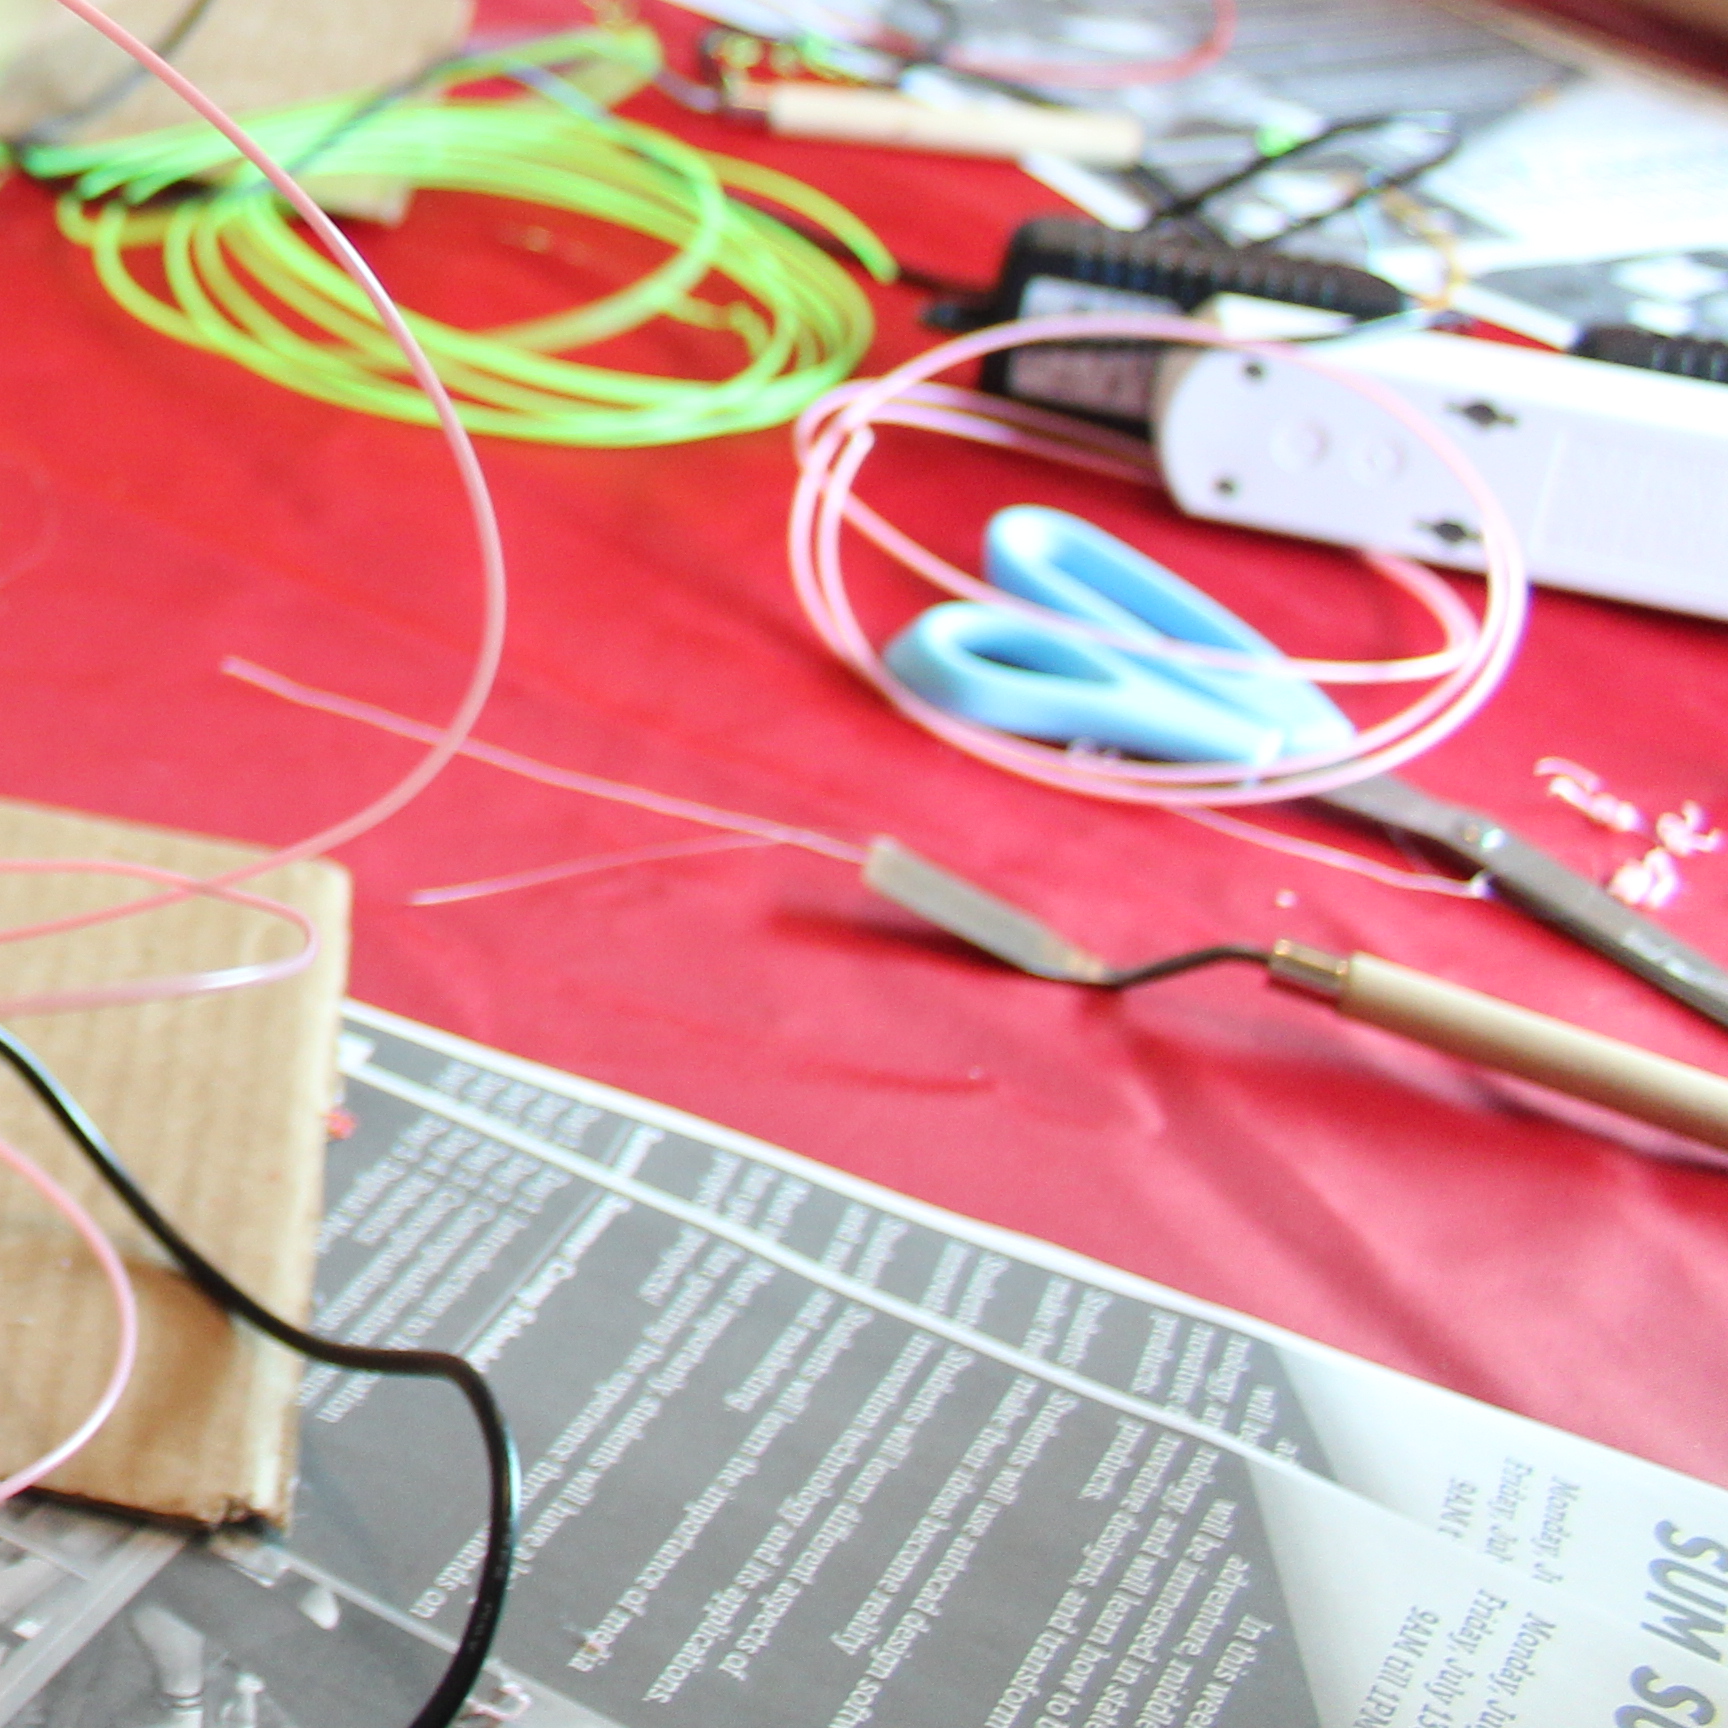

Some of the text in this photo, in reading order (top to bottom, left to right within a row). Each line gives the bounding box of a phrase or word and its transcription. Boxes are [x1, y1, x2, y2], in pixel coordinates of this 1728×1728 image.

[986, 1464, 1022, 1506] will
[963, 1501, 999, 1536] use
[1141, 1516, 1178, 1561] and
[1200, 1500, 1235, 1544] will
[879, 1511, 948, 1592] become
[1071, 1511, 1137, 1585] designs,
[1185, 1528, 1222, 1568] be
[1119, 1549, 1156, 1601] will
[832, 1591, 891, 1654] reality
[1047, 1589, 1087, 1641] and
[1088, 1585, 1141, 1644] learn
[1129, 1560, 1204, 1661] immersed
[1175, 1556, 1248, 1654] adventure,
[1448, 1590, 1507, 1654] Friday,
[868, 1607, 928, 1678] design
[1393, 1607, 1439, 1657] 9AM
[1489, 1613, 1554, 1695] Monday,
[719, 1646, 748, 1680] of
[1062, 1638, 1110, 1692] how
[1112, 1652, 1149, 1684] in
[1186, 1615, 1272, 1728] In this wee
[1376, 1656, 1413, 1689] till
[1424, 1658, 1474, 1705] July
[1046, 1691, 1080, 1726] to
